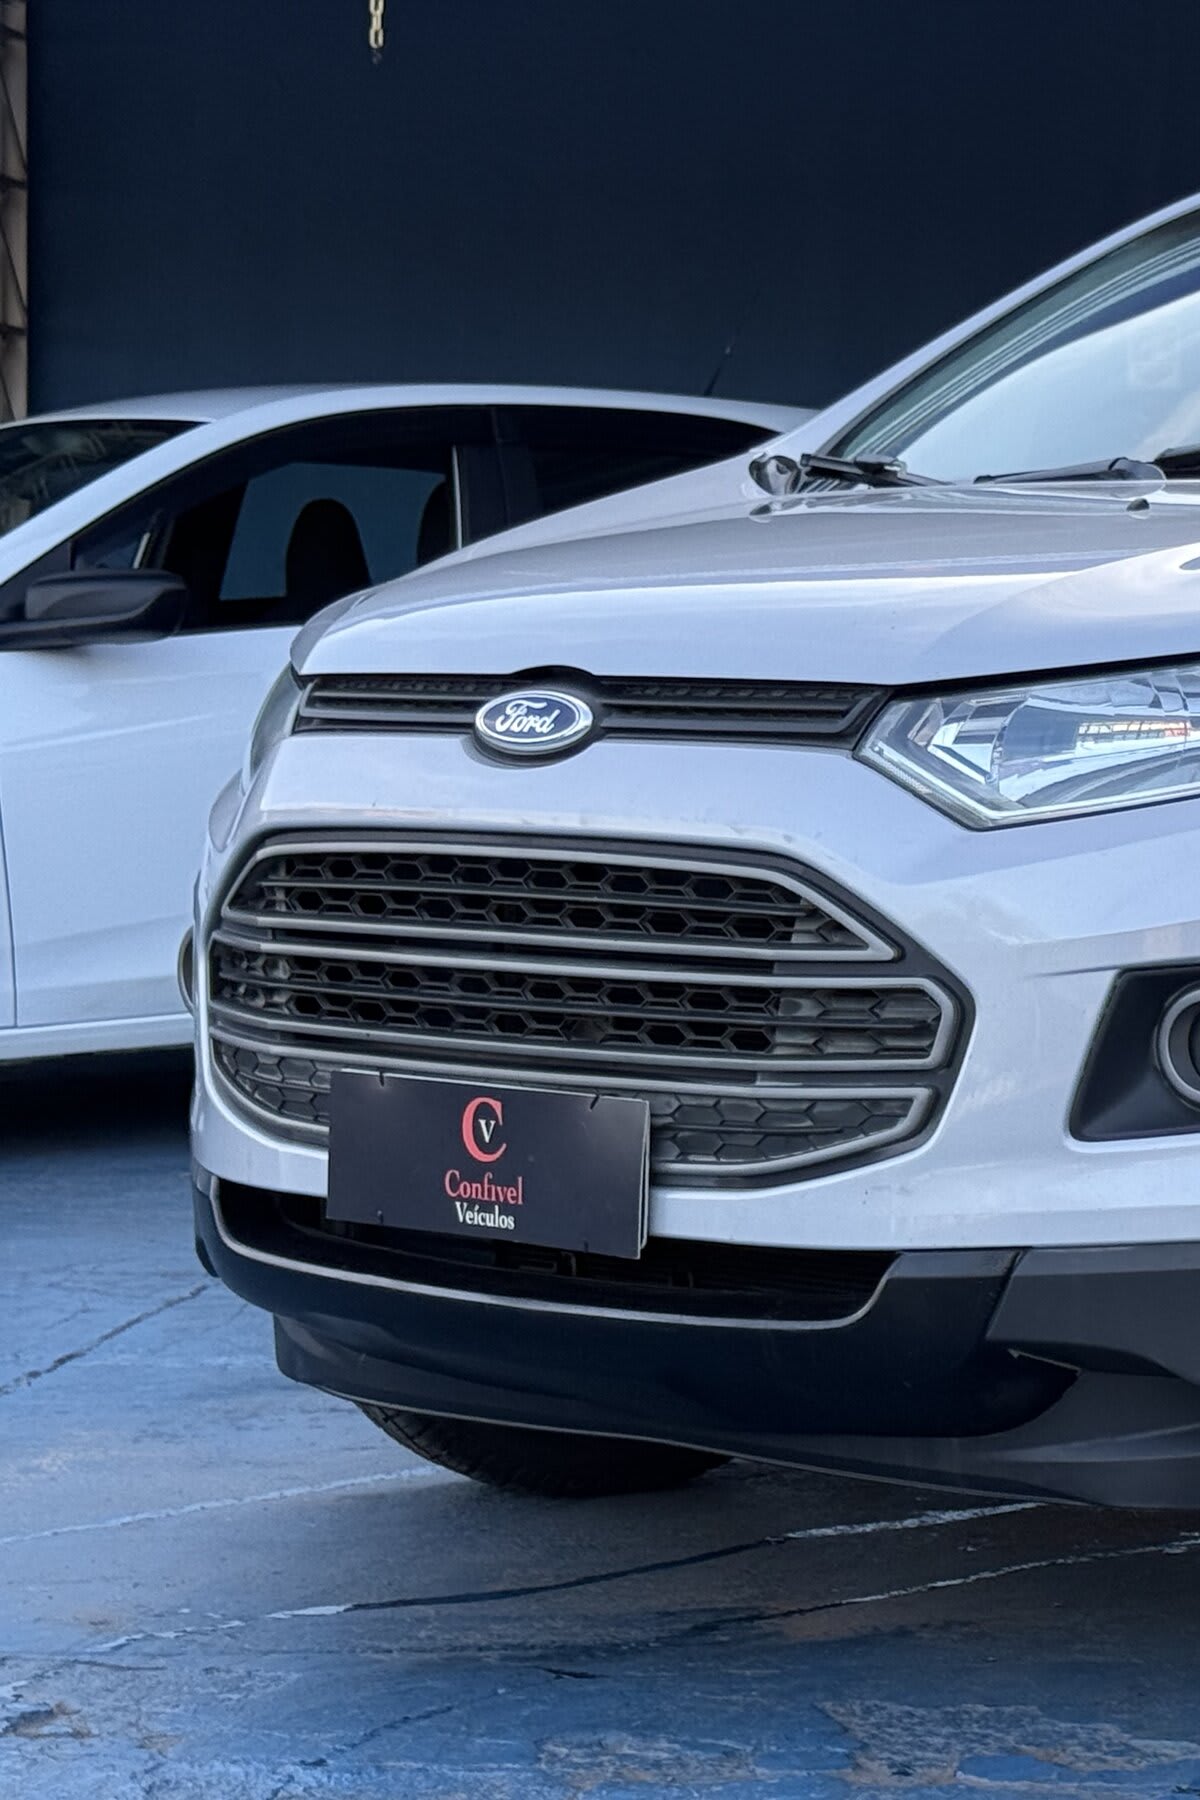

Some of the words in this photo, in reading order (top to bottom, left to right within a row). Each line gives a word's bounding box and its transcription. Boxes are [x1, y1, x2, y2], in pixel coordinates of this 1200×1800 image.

[495, 700, 560, 733] Ford
[444, 1169, 523, 1205] Confivel
[455, 1201, 515, 1230] Veículos
